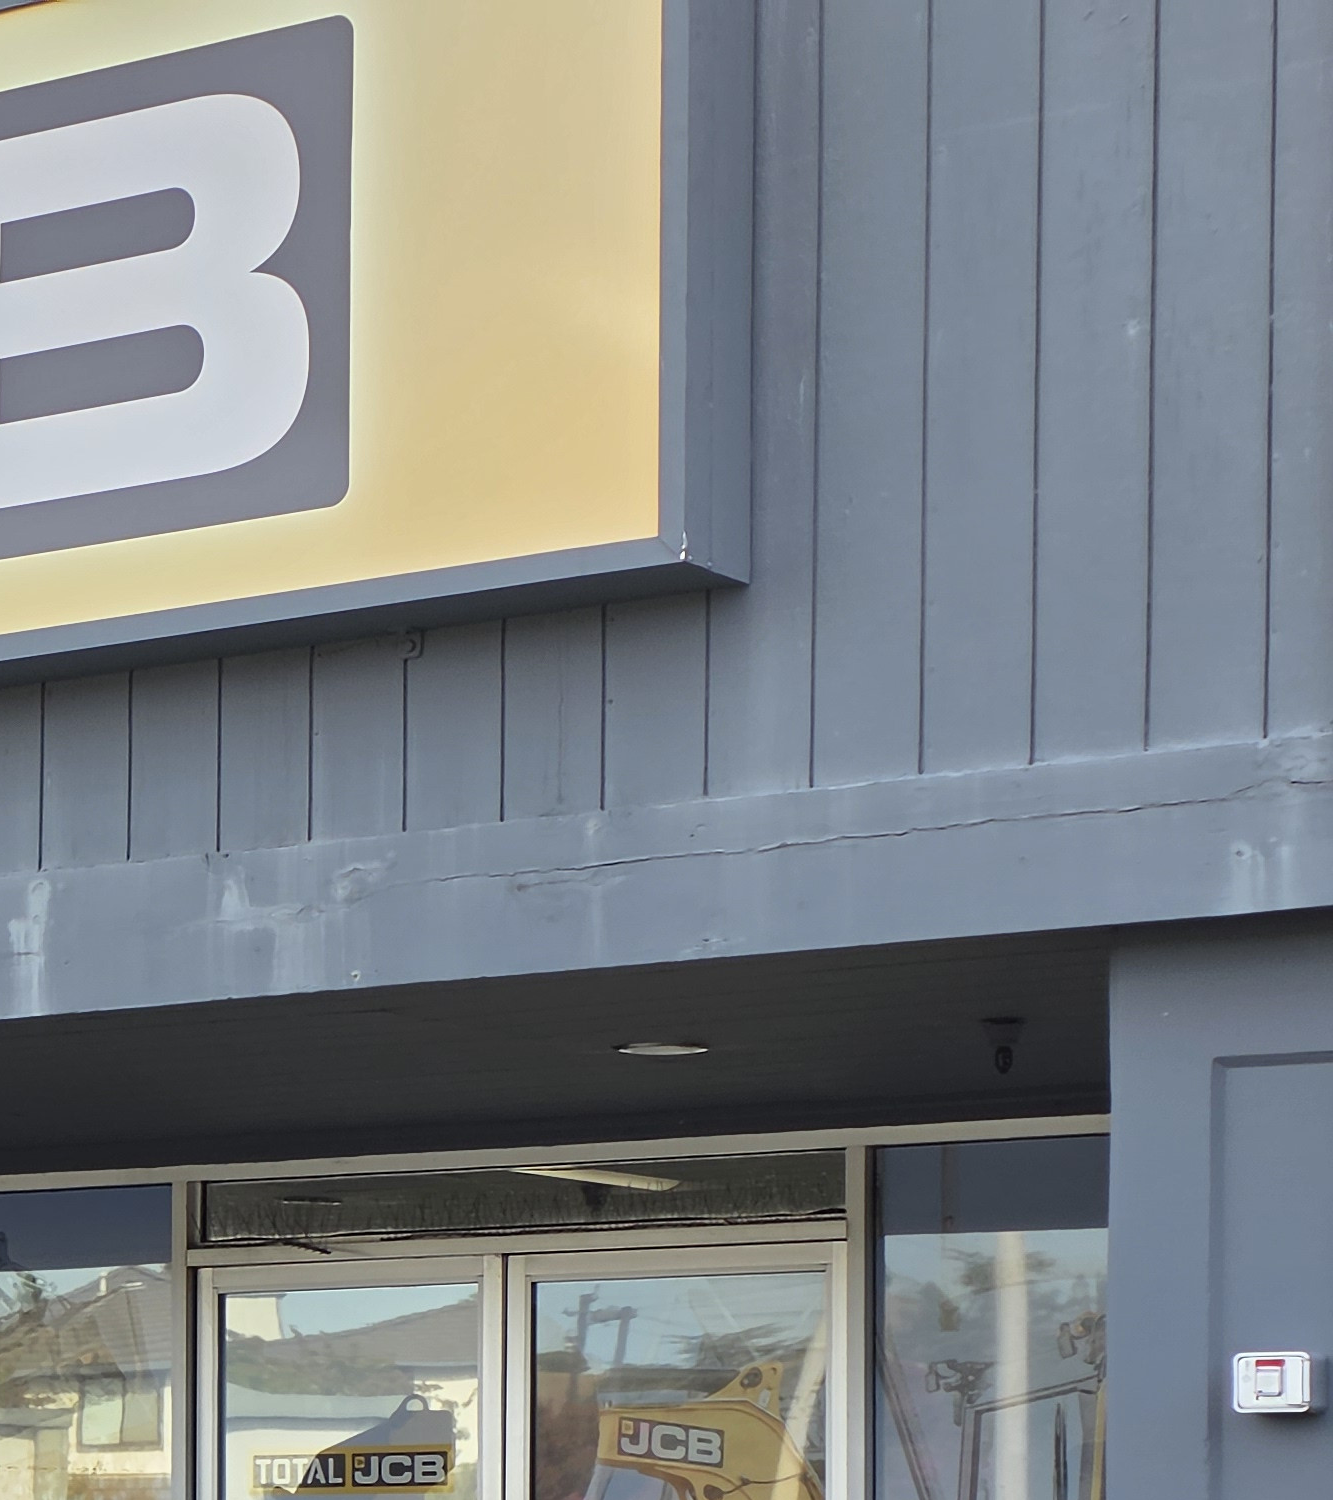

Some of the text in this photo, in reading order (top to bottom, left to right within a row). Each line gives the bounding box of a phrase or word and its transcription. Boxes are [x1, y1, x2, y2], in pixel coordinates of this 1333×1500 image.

[620, 1422, 722, 1464] JCB
[255, 1455, 445, 1486] TOTAL JCB
